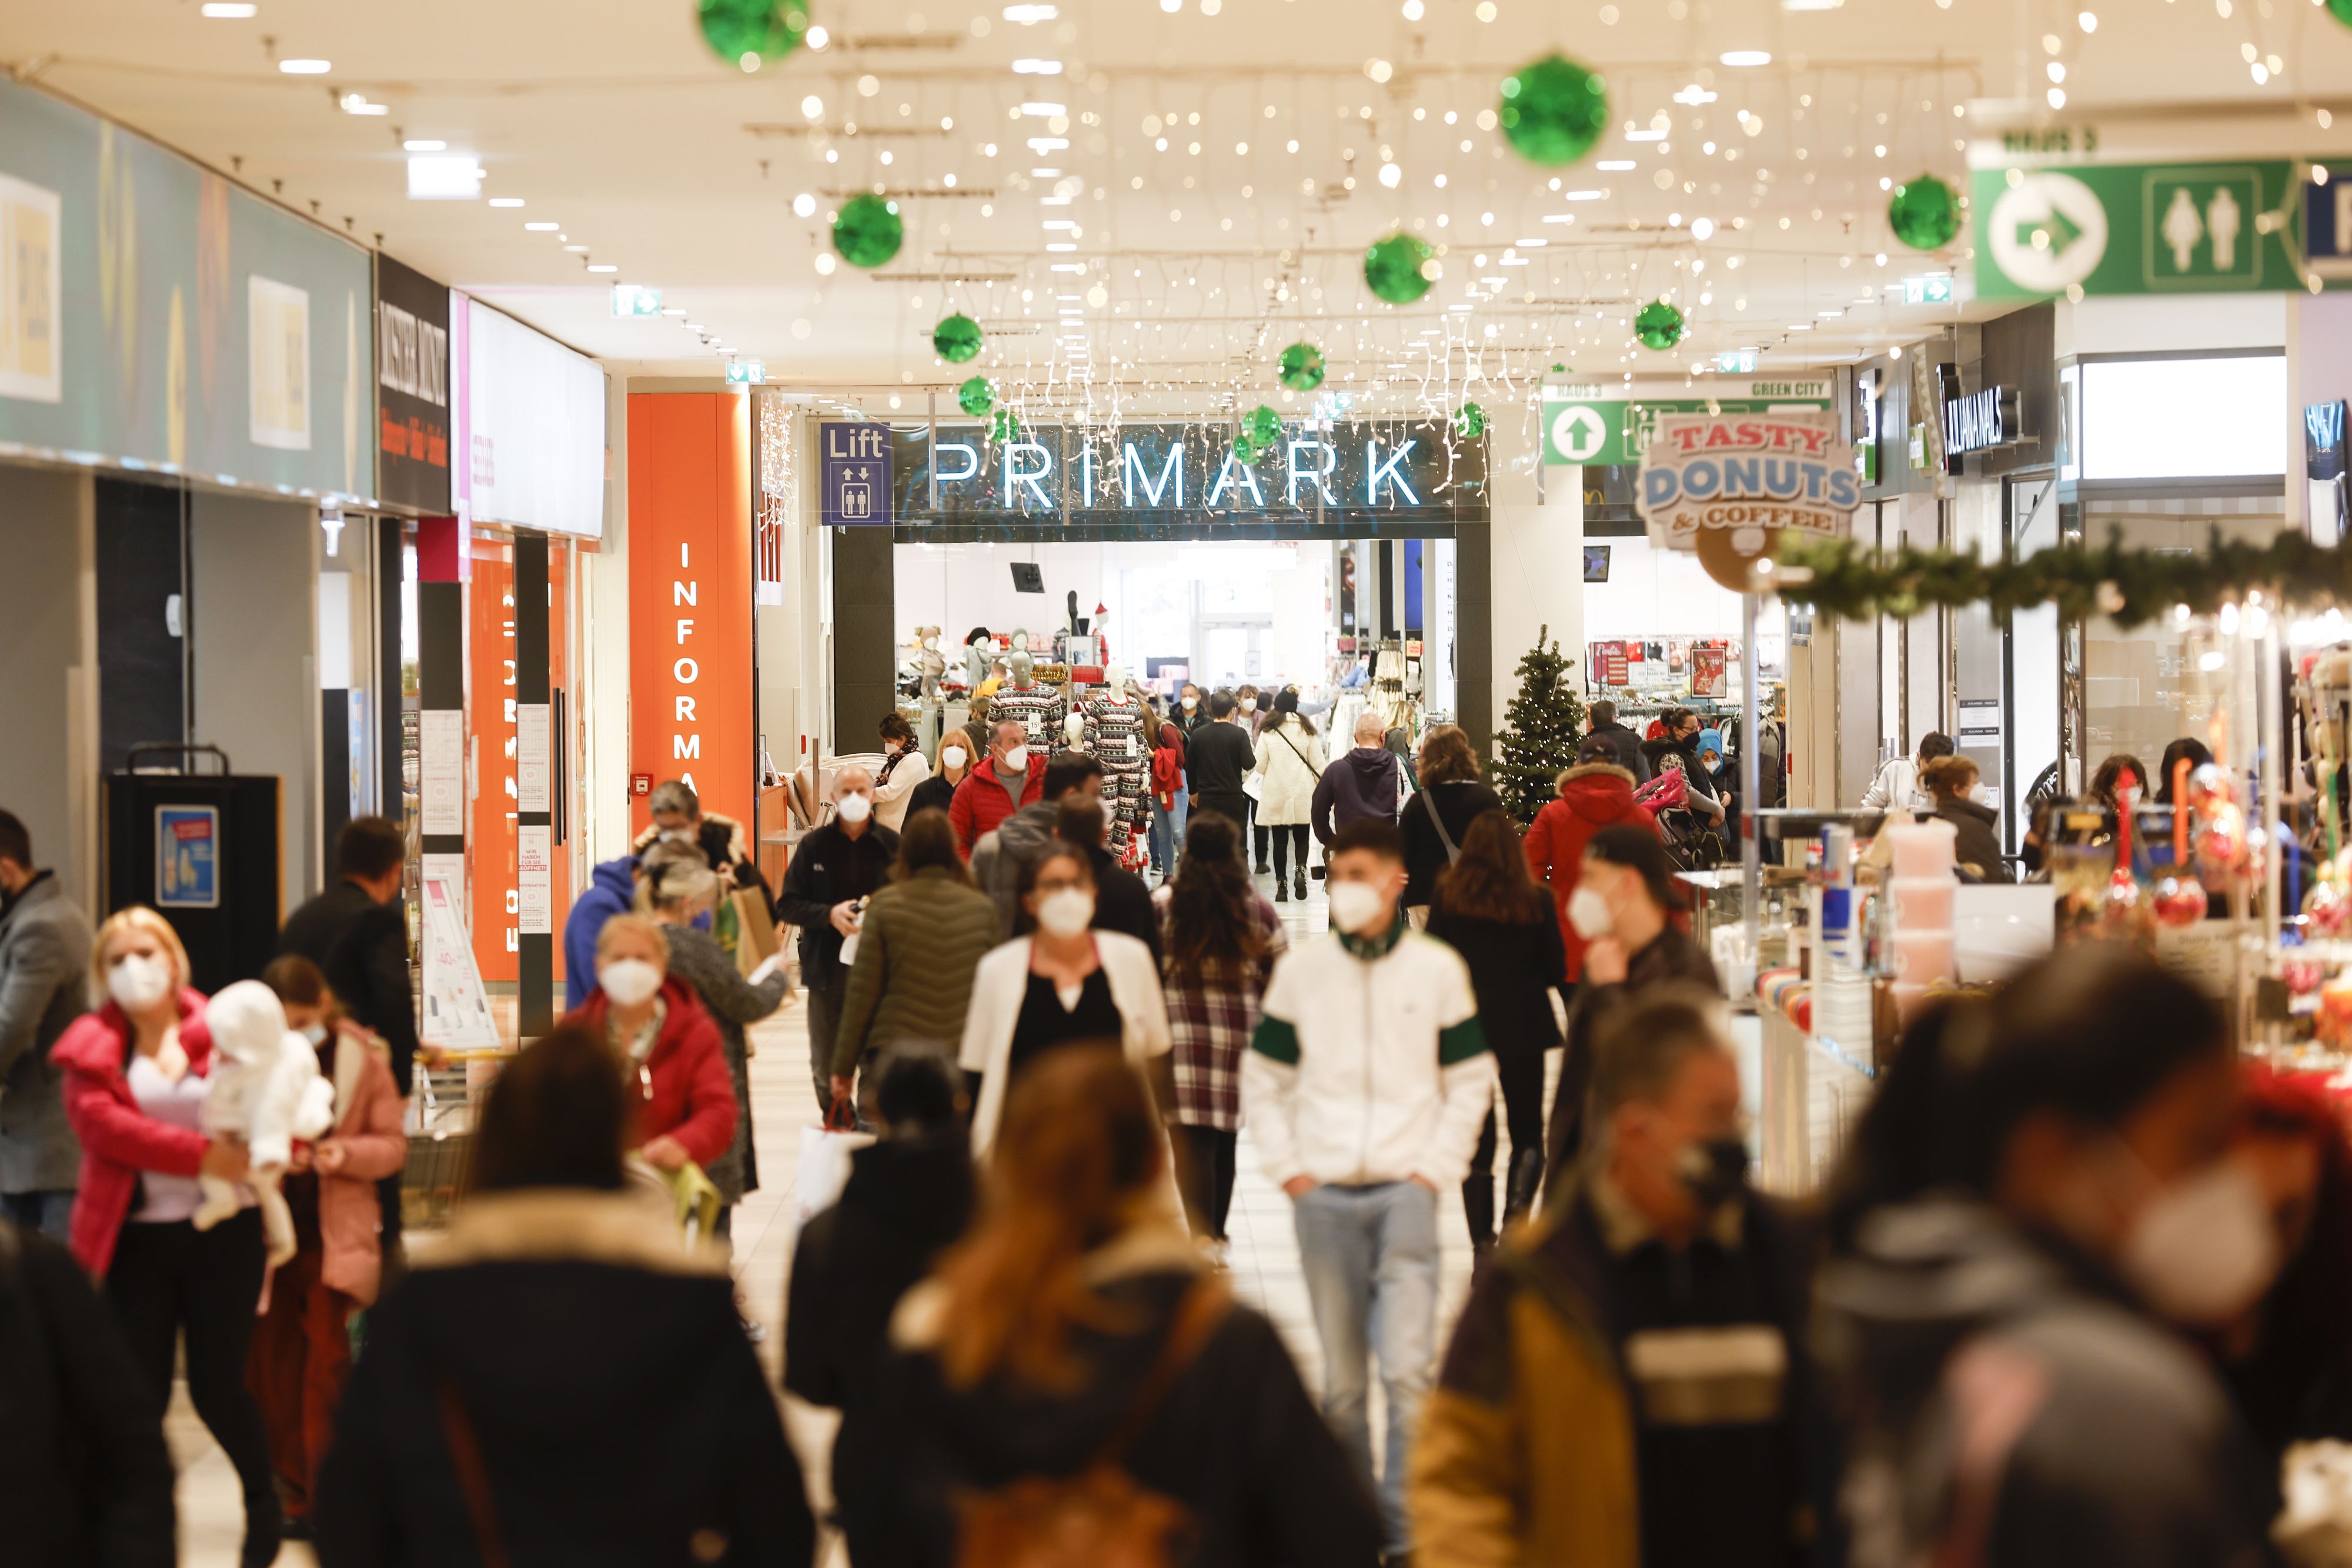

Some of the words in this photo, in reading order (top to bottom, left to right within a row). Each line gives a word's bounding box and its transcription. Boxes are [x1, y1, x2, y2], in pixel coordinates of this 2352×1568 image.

[1557, 383, 1589, 397] HAUS
[1594, 383, 1602, 397] 3
[1752, 383, 1792, 396] GREEN
[1795, 382, 1824, 396] CITY
[830, 429, 883, 457] Lift
[1672, 422, 1828, 452] TASTY
[929, 440, 1419, 509] PRIMARK
[1646, 458, 1857, 507] DONUTS
[1672, 512, 1695, 530] &
[1706, 506, 1833, 530] COFFEE
